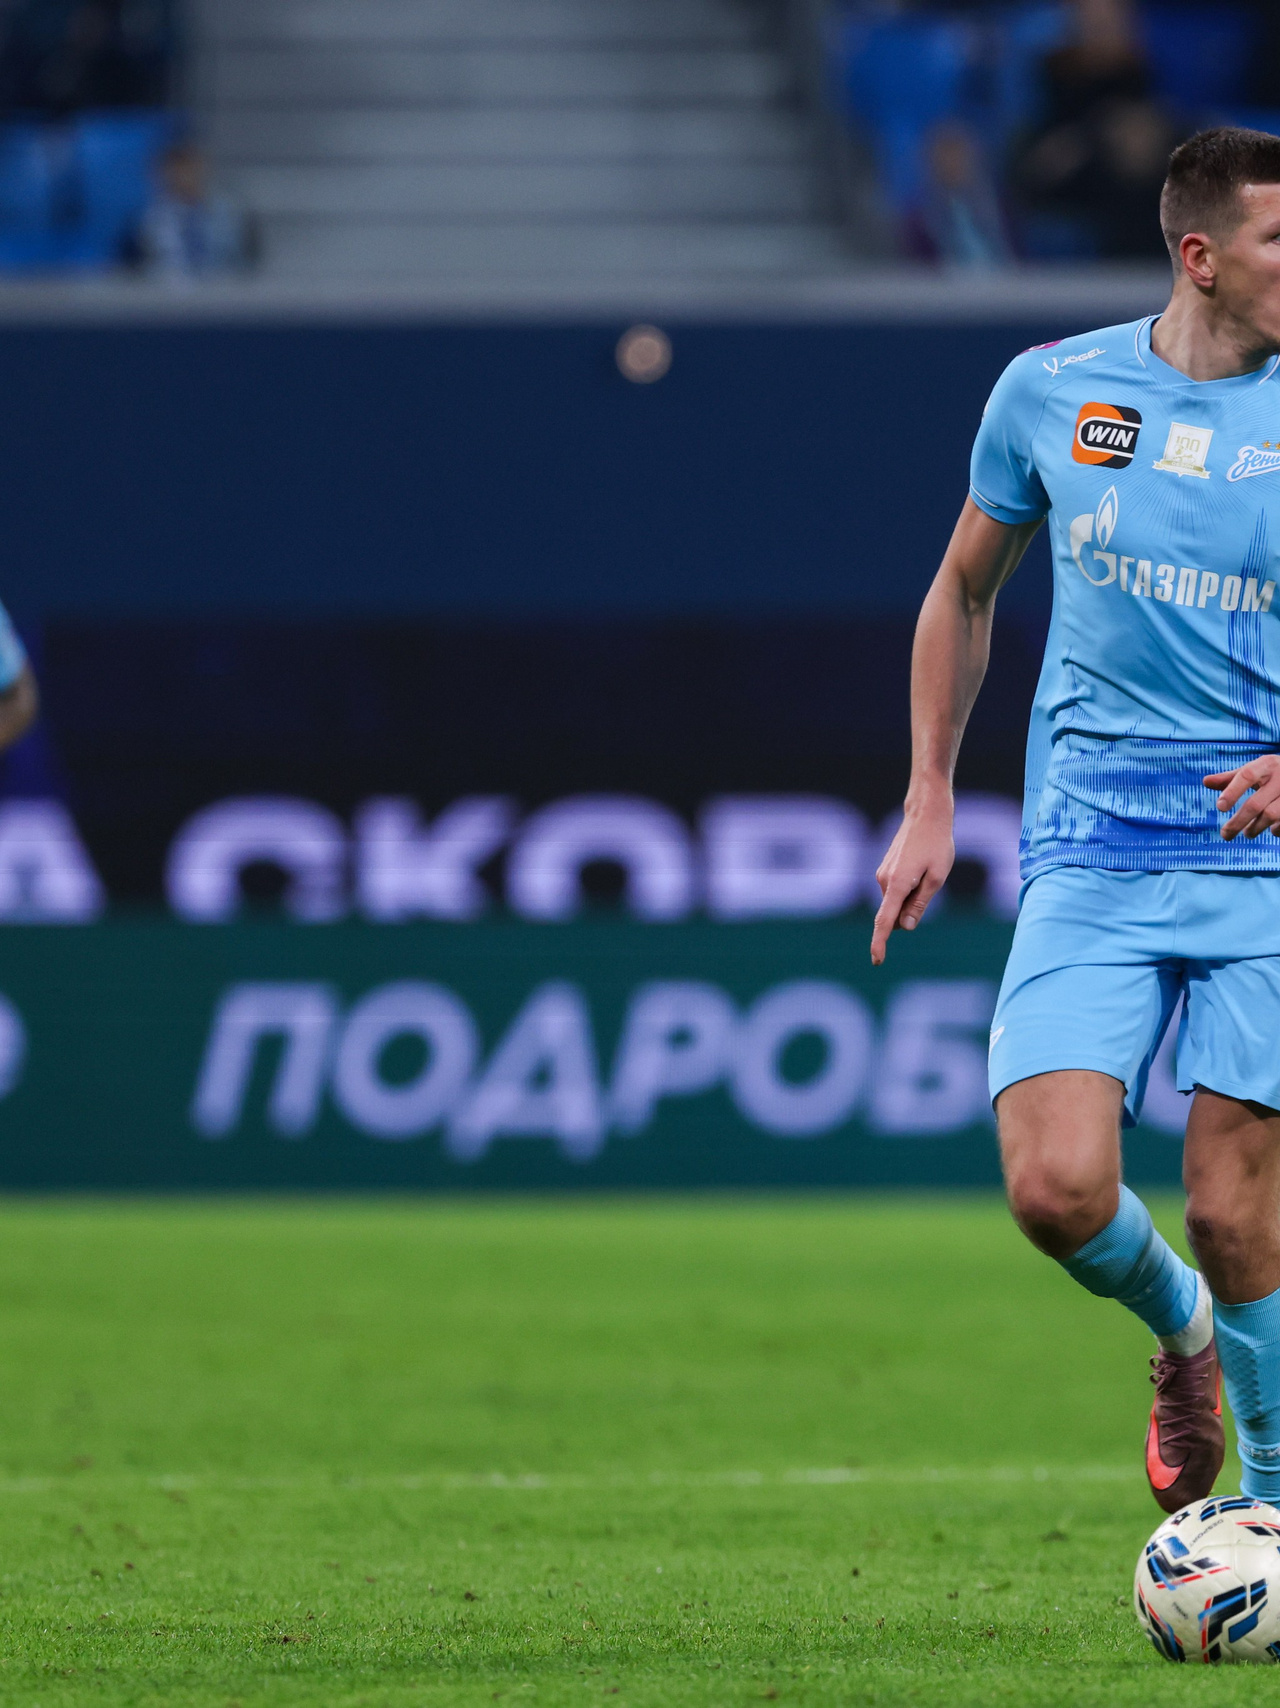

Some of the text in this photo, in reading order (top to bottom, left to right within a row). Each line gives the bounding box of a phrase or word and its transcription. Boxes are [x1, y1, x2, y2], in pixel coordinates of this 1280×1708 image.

[1061, 348, 1106, 367] JÖGEL
[1087, 424, 1135, 448] WIN
[1119, 555, 1276, 613] ГАЗПРОМ
